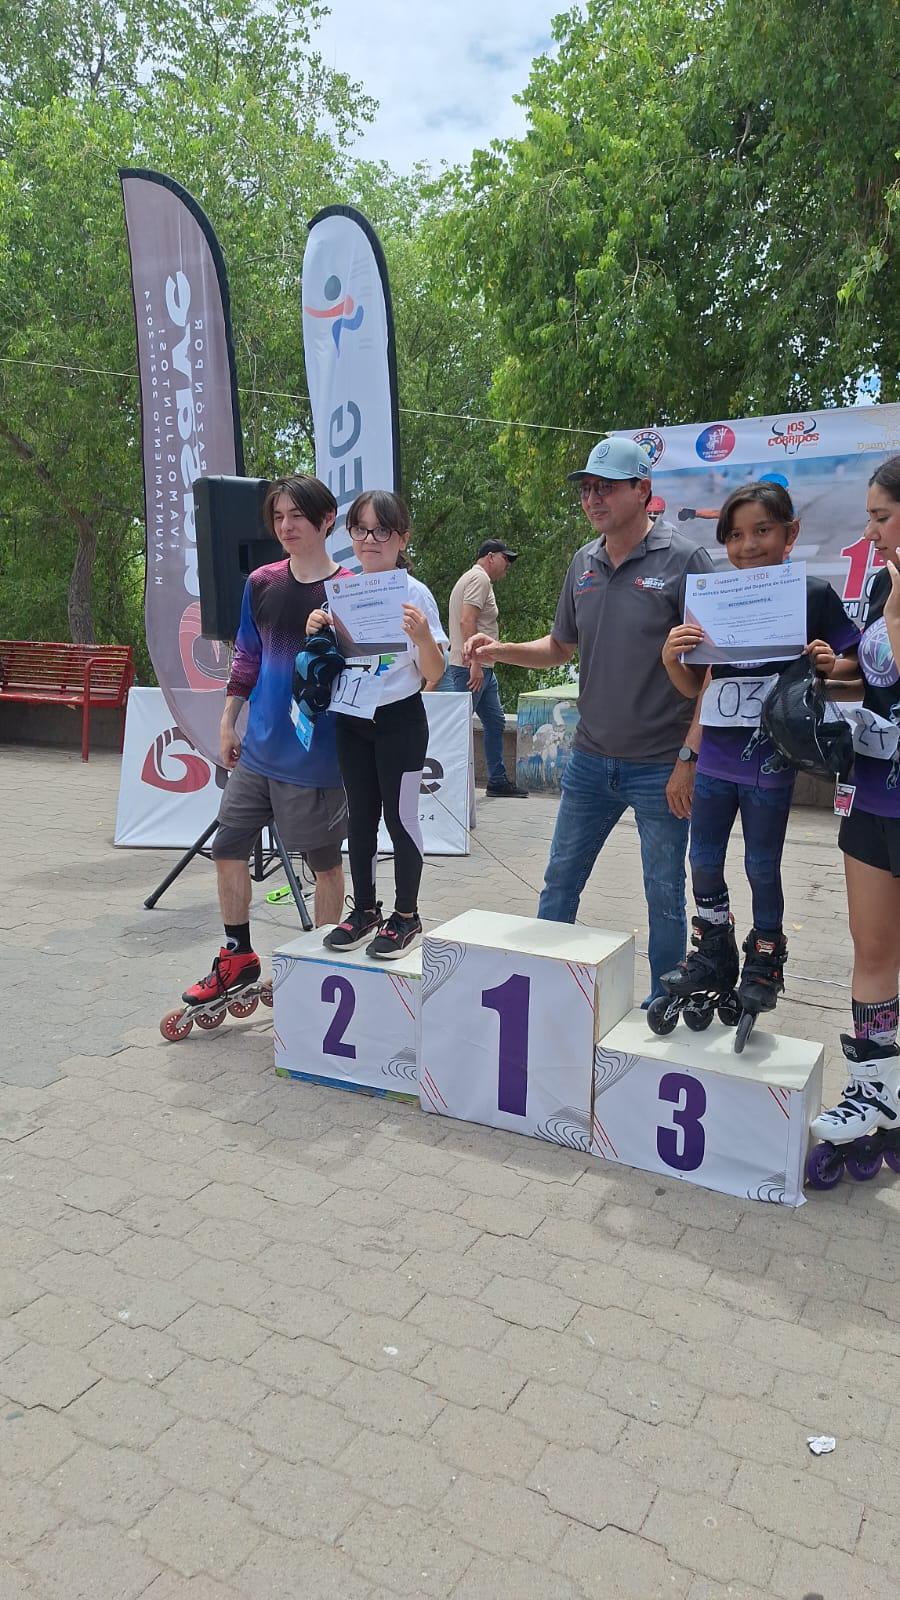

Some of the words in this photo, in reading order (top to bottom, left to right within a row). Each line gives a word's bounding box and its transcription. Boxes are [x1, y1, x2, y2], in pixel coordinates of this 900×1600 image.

[768, 432, 820, 447] CORRIDOS
[786, 420, 806, 435] LOS
[333, 675, 361, 708] 01
[718, 681, 764, 719] 03
[320, 974, 357, 1060] 2
[481, 973, 531, 1117] 1
[656, 1072, 707, 1172] 3
